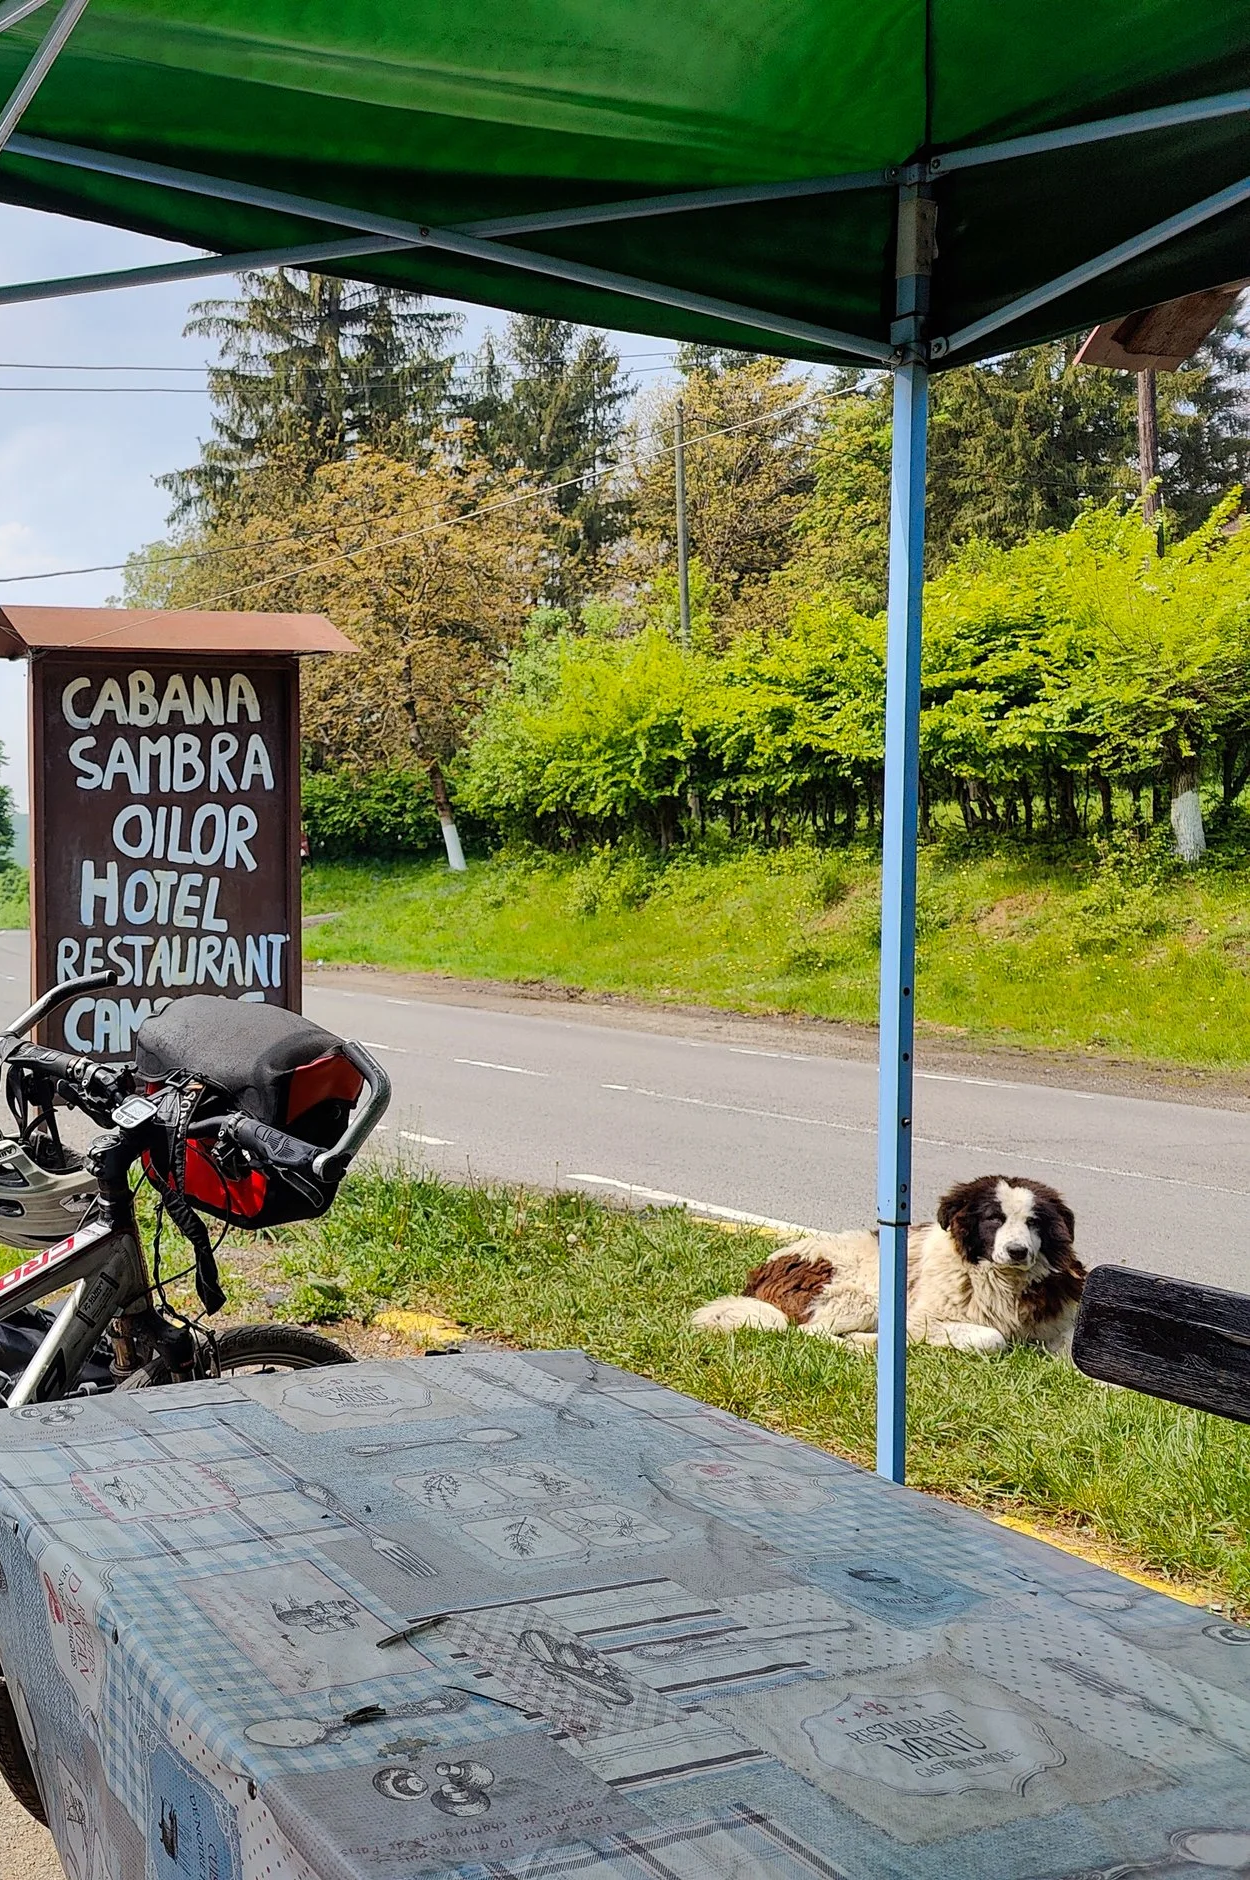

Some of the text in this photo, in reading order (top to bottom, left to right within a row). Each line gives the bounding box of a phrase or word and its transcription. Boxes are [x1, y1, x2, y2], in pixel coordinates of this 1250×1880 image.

[61, 670, 261, 729] CABANA
[68, 732, 274, 794] SAMBRA
[112, 803, 258, 872] OILOR
[80, 860, 229, 932] HOTEL
[56, 933, 290, 988] RESTAURANT
[844, 1709, 967, 1744] RESTAURANT
[884, 1728, 987, 1764] MENU
[915, 1749, 1020, 1778] GASTRONOMIQUE
